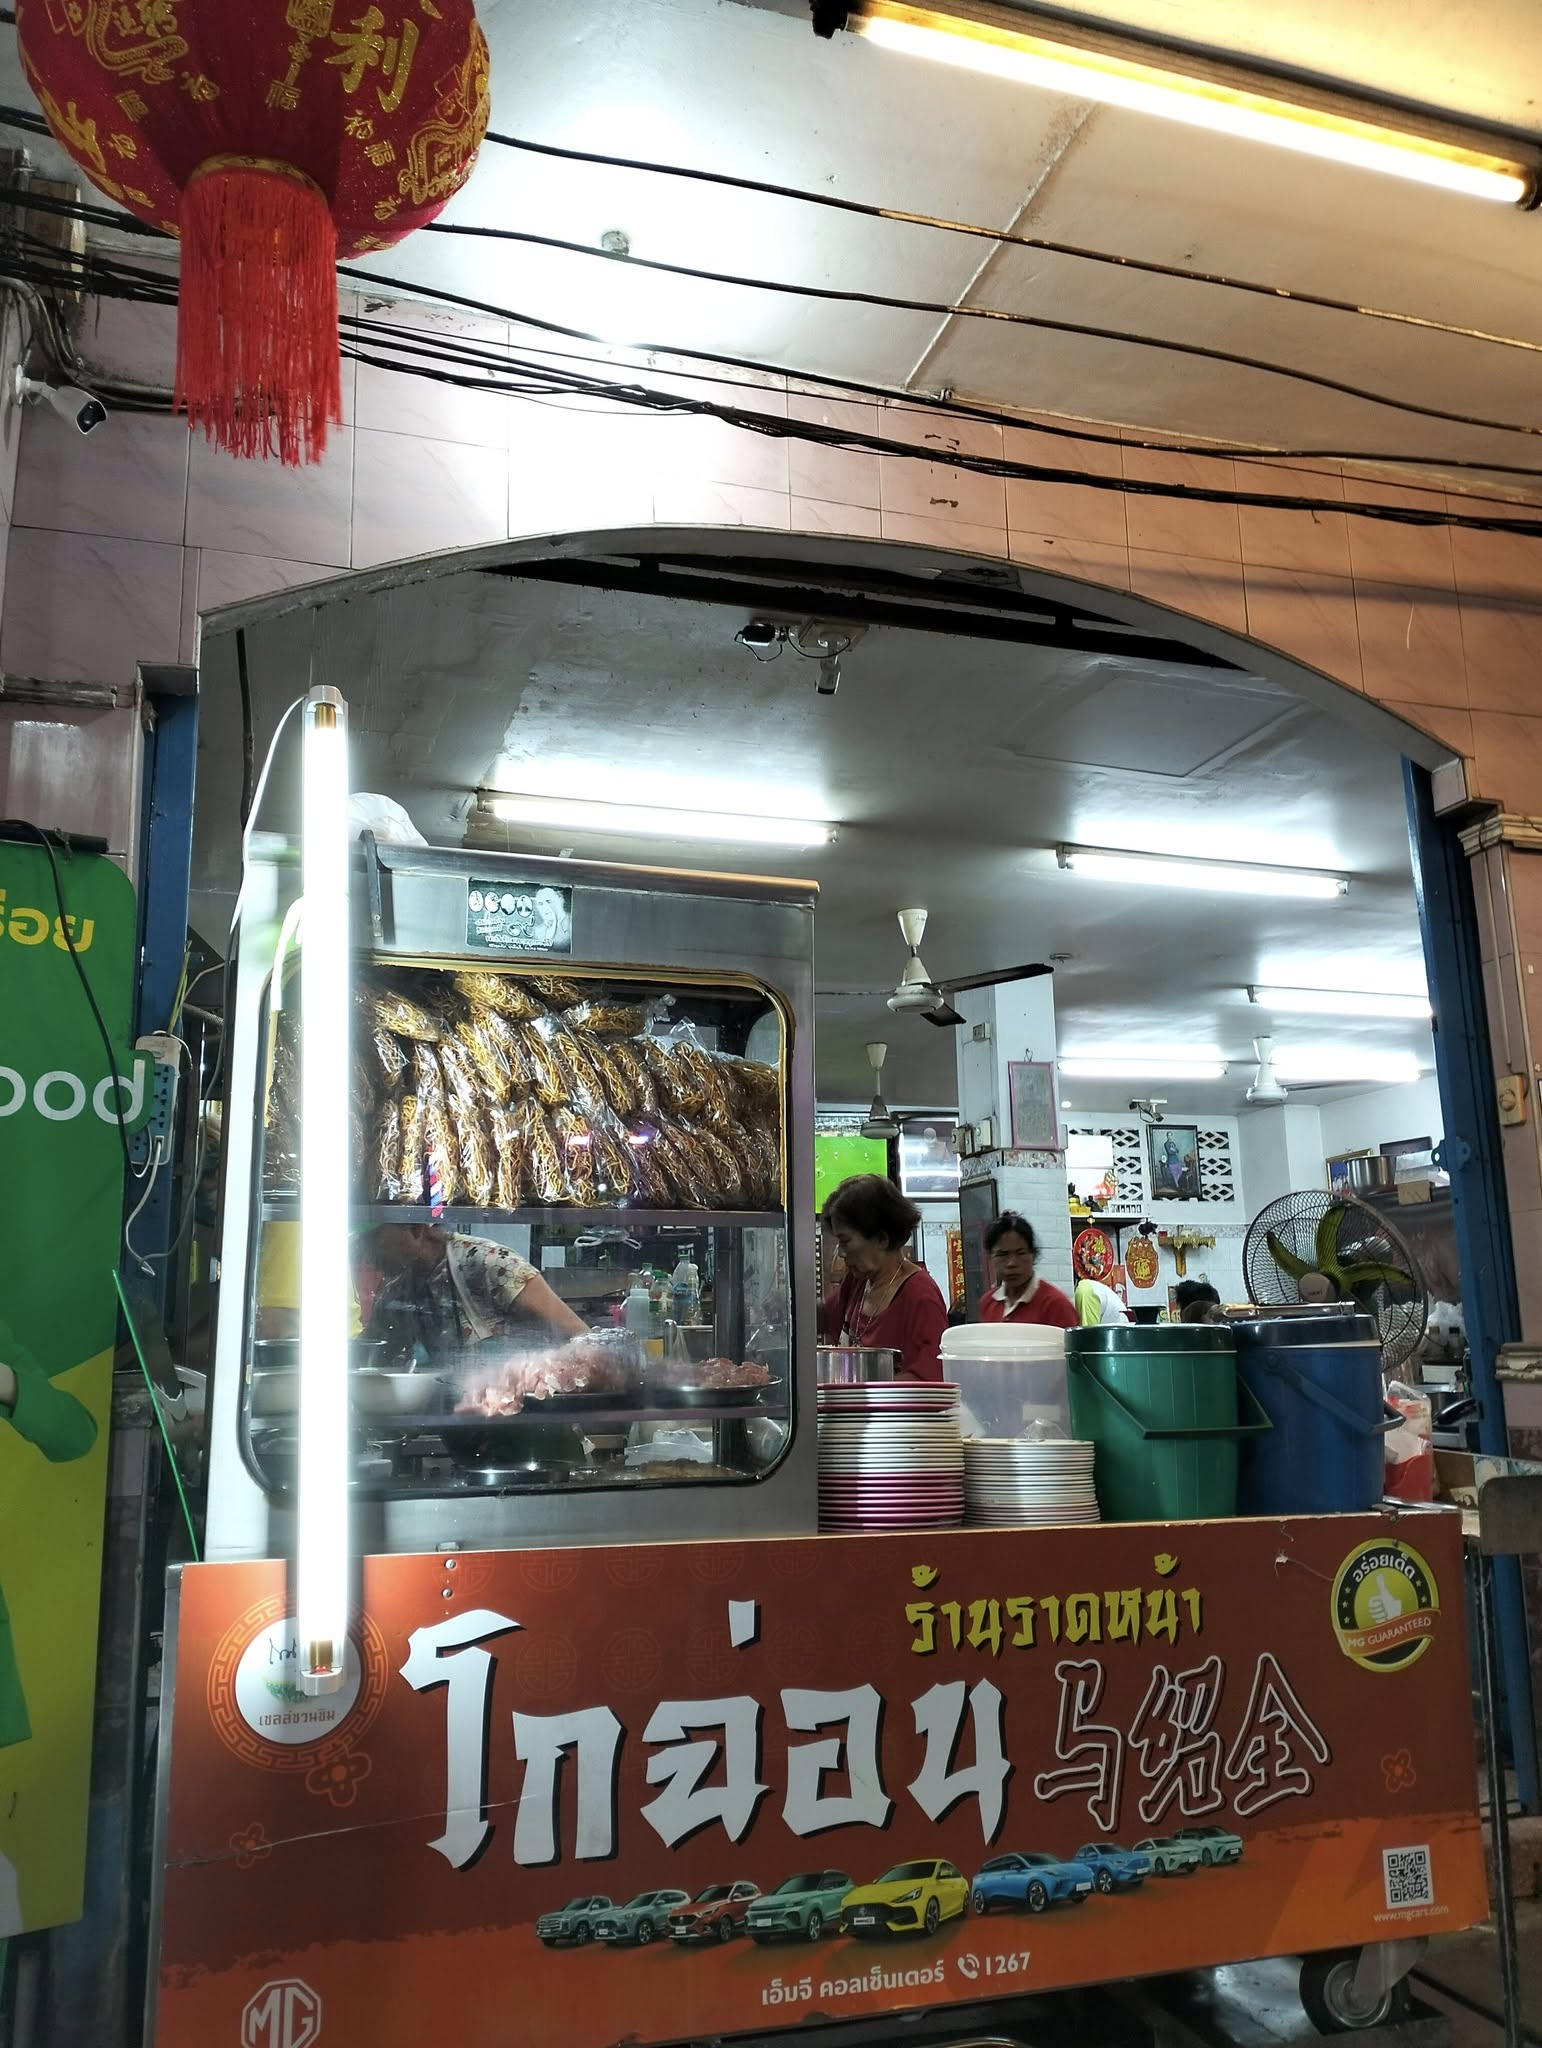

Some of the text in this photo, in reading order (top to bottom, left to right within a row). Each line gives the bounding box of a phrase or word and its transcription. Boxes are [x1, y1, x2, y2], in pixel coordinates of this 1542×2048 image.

[324, 5, 419, 113] 利
[1352, 1552, 1416, 1583] อร่อยเด็ด
[904, 1553, 1202, 1657] ร้านราดหน้า
[1367, 1617, 1432, 1645] GUARANTEED
[259, 1708, 336, 1726] เชลล์ชวนชิม
[1373, 1905, 1449, 1923] www.mgcars.com
[761, 1951, 1031, 2006] เอ็มจี คอลเซ็นเตอร์ 1267
[248, 1987, 314, 2048] MG
